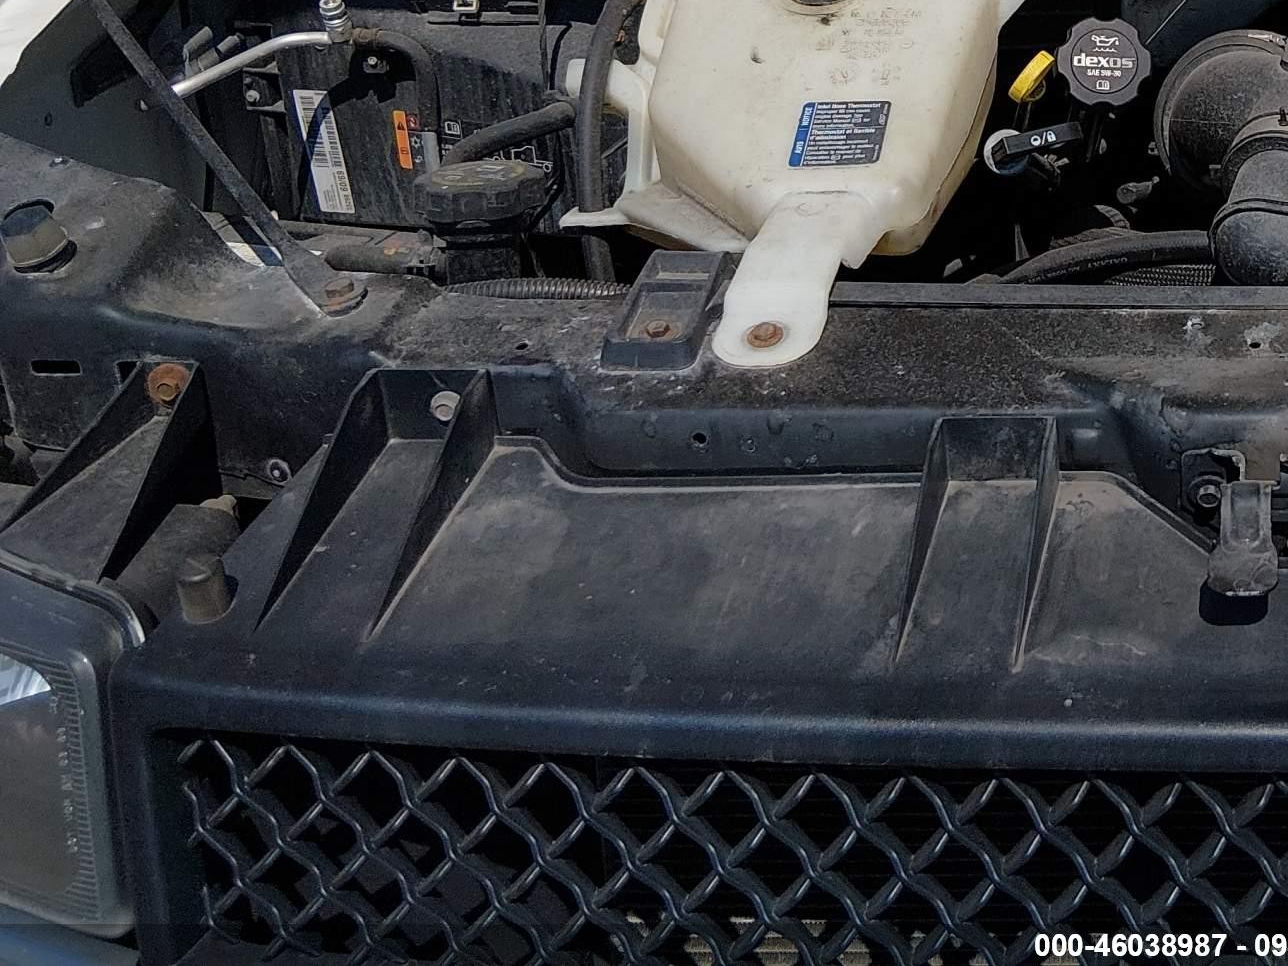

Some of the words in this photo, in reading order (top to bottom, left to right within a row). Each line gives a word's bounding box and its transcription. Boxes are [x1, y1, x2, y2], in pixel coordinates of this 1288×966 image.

[1073, 53, 1136, 68] dexos
[1087, 68, 1100, 76] SAE
[1101, 69, 1122, 77] 5W-30
[801, 107, 813, 126] NOTICE
